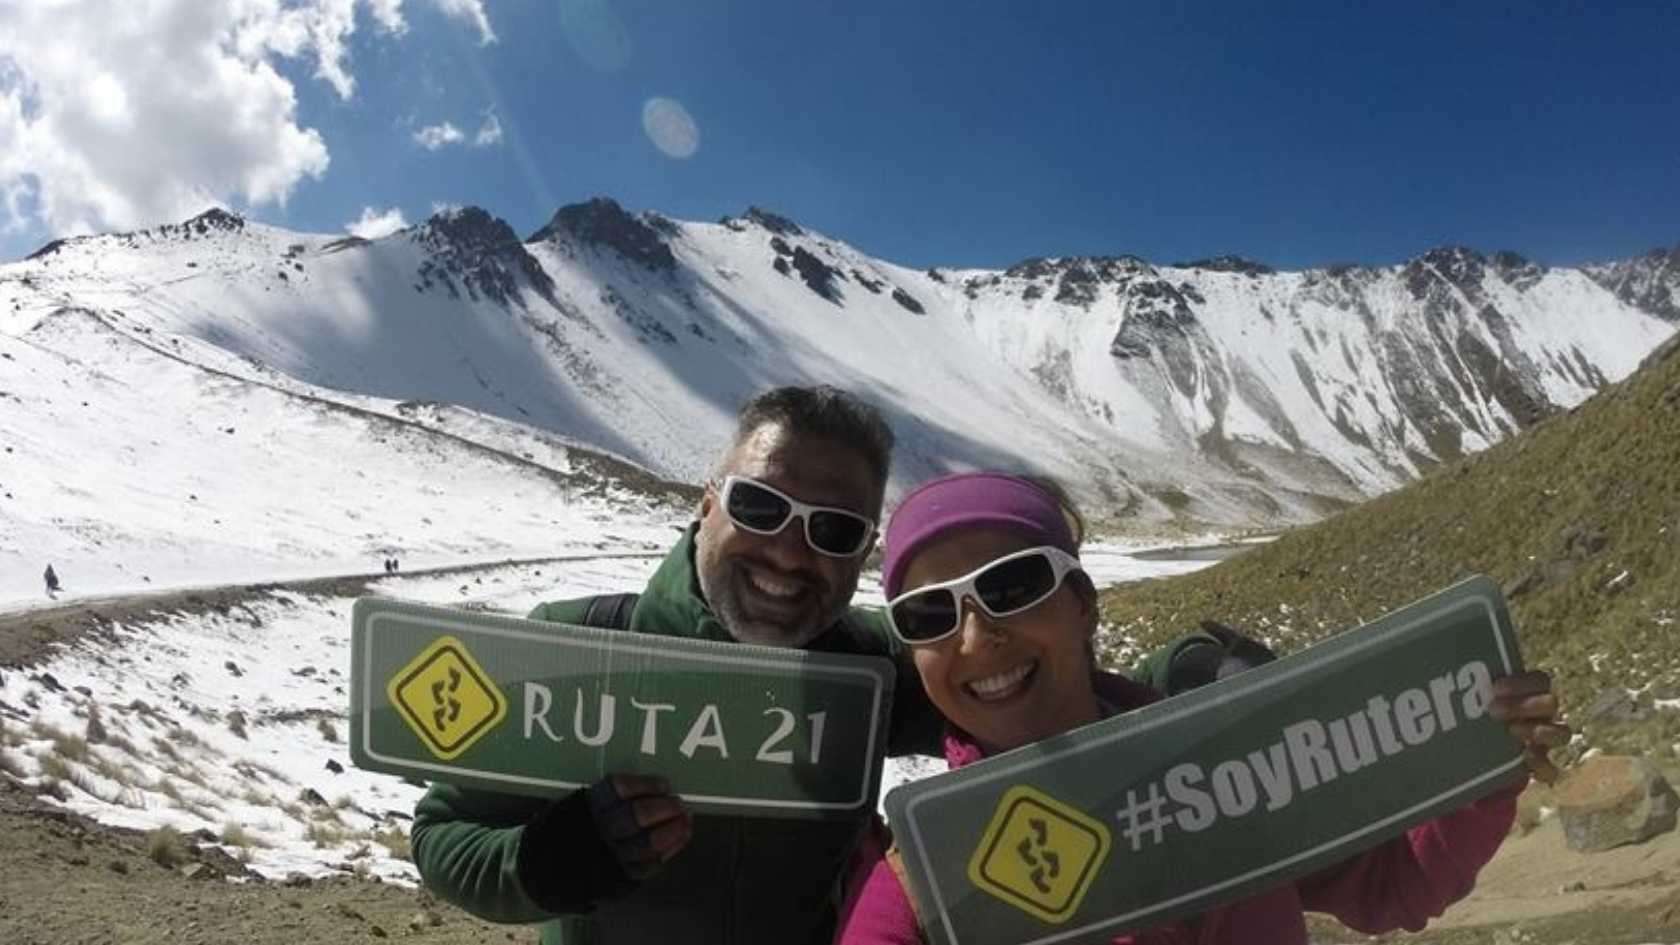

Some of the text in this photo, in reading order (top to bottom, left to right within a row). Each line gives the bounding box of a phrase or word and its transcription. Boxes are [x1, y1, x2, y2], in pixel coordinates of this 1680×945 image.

[523, 681, 826, 764] RUTA 21
[1116, 660, 1494, 851] #SoyRutera
